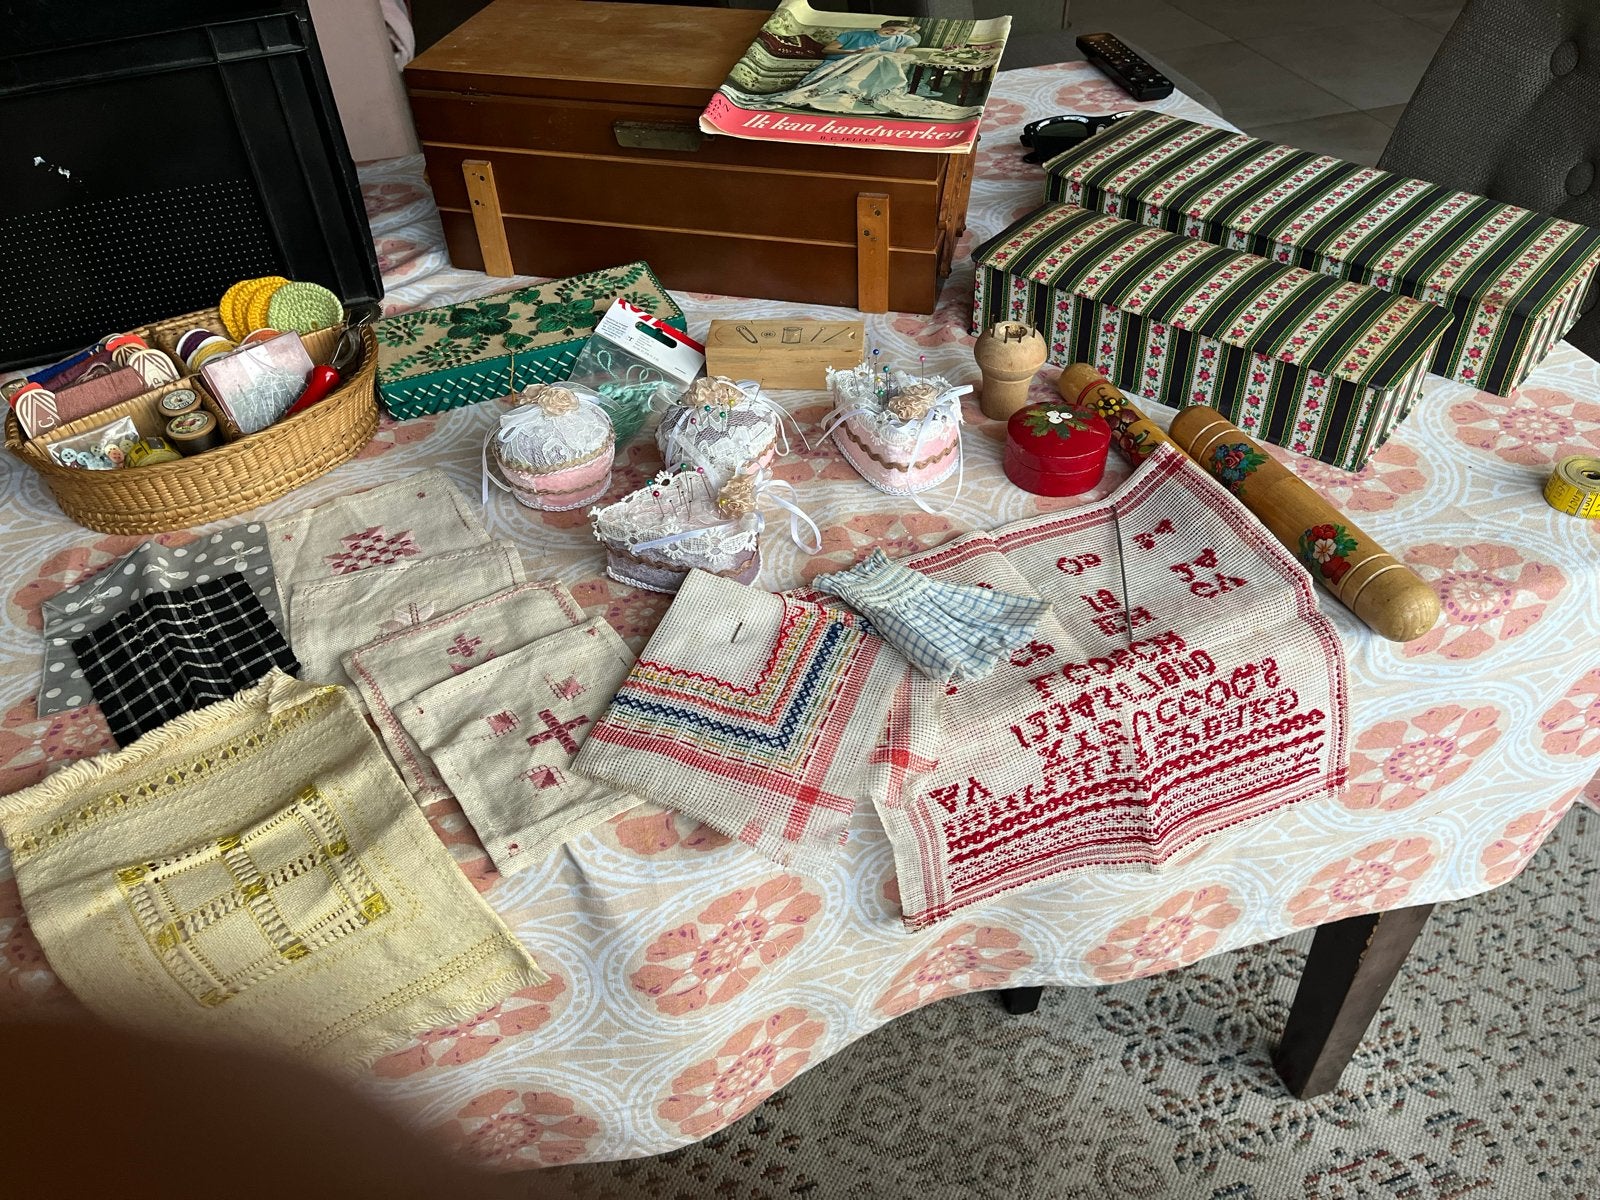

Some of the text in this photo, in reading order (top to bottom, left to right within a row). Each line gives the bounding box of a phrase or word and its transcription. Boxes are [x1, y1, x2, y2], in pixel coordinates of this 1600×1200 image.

[741, 113, 966, 141] Ik kan handwerken
